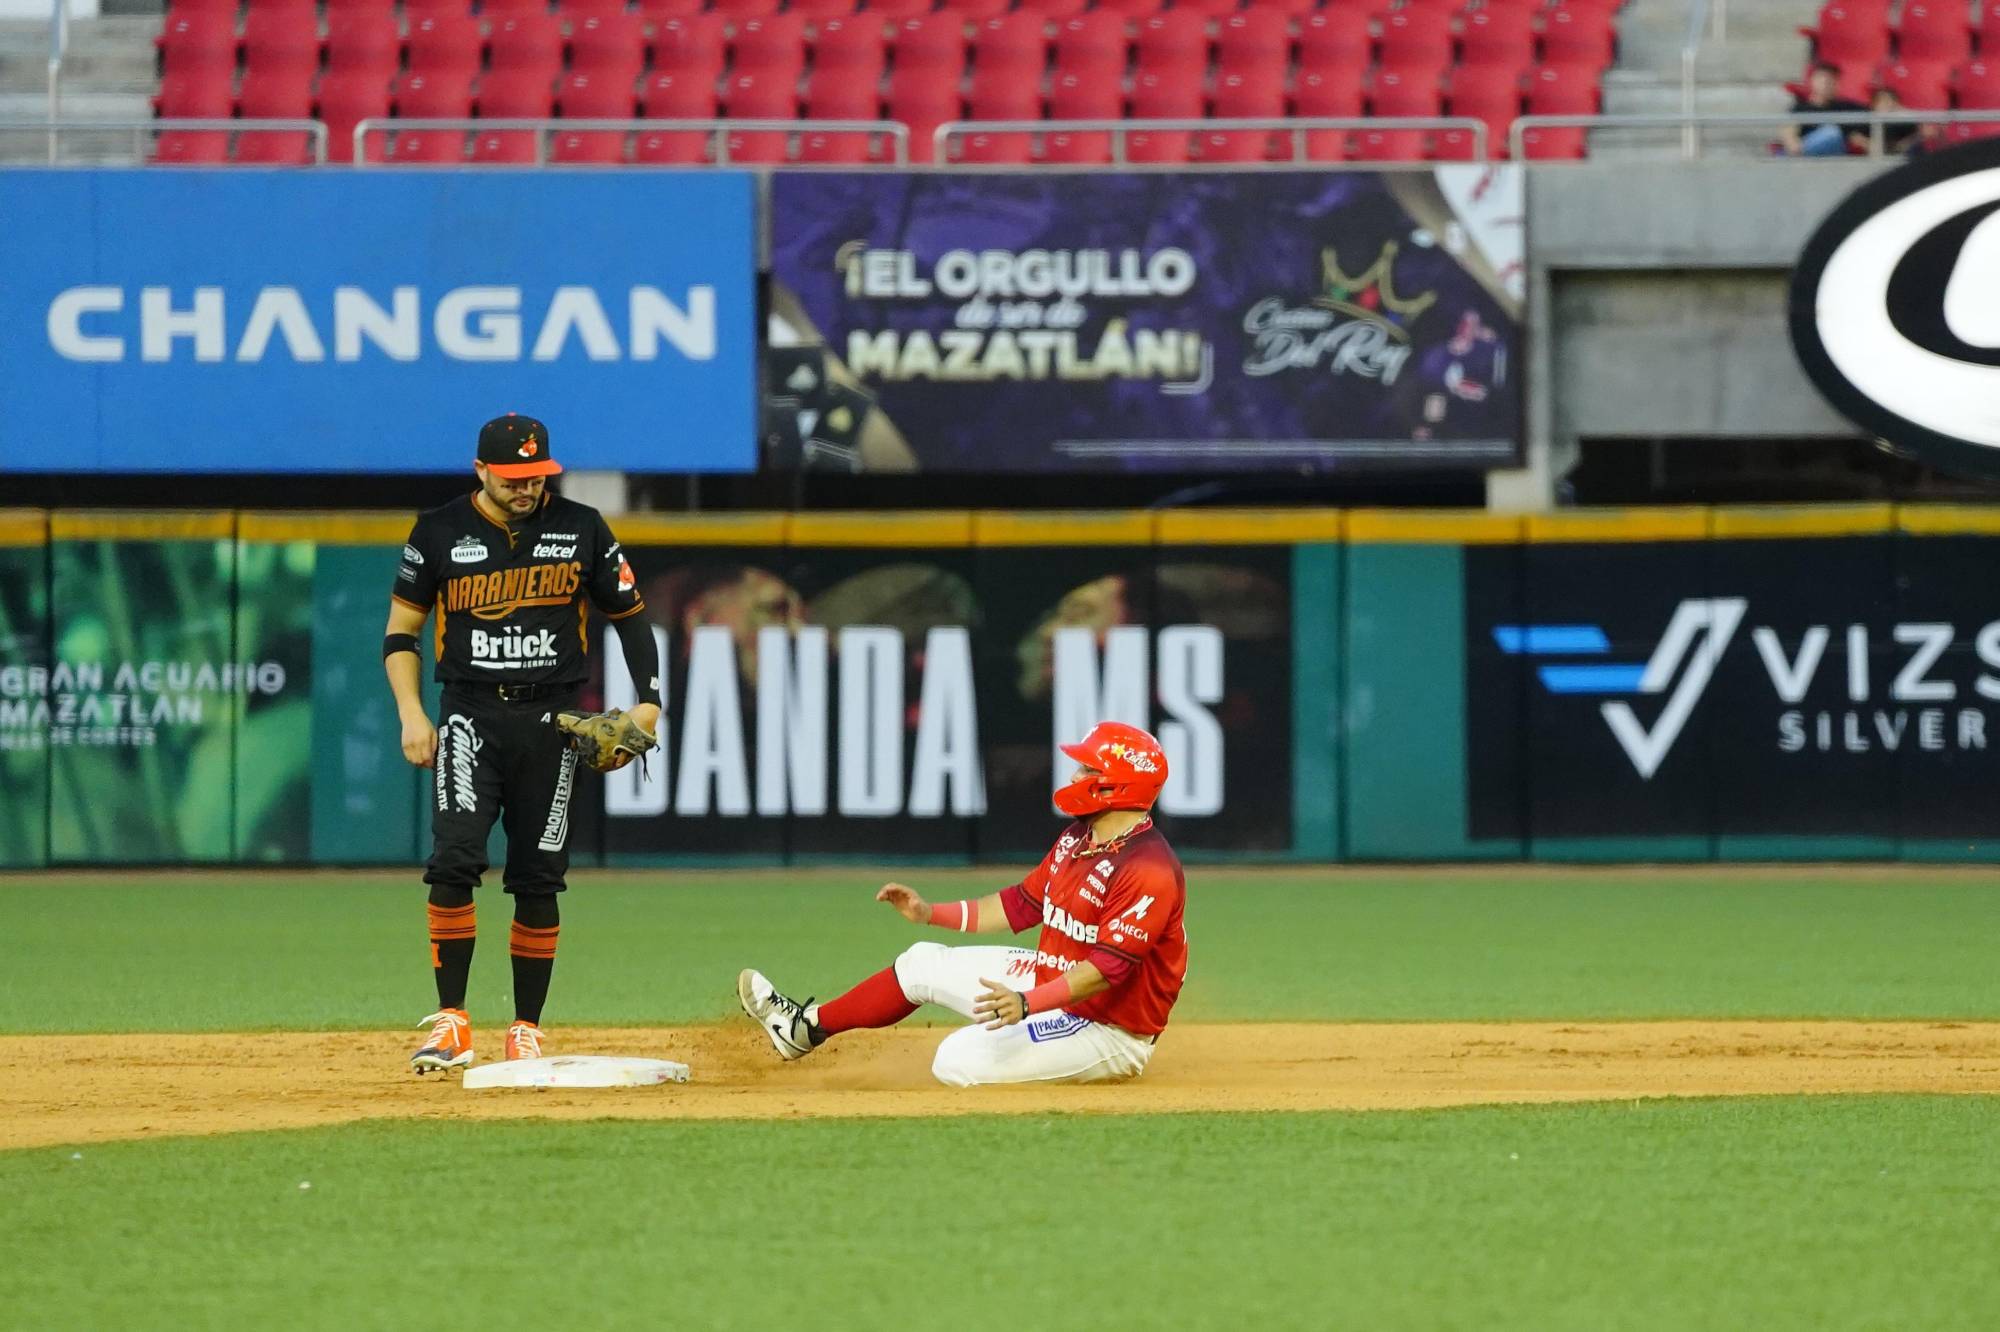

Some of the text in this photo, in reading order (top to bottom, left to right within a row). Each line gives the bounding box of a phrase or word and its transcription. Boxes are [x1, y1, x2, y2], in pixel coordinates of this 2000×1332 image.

[934, 246, 1196, 298] ORGULLO
[47, 285, 716, 362] CHANGAN
[532, 543, 577, 559] telcel
[447, 561, 582, 613] NARANJEROS
[471, 625, 558, 659] Brück
[0, 660, 103, 697] GRAN
[1053, 623, 1225, 818] MS
[1777, 709, 1988, 752] SILVER
